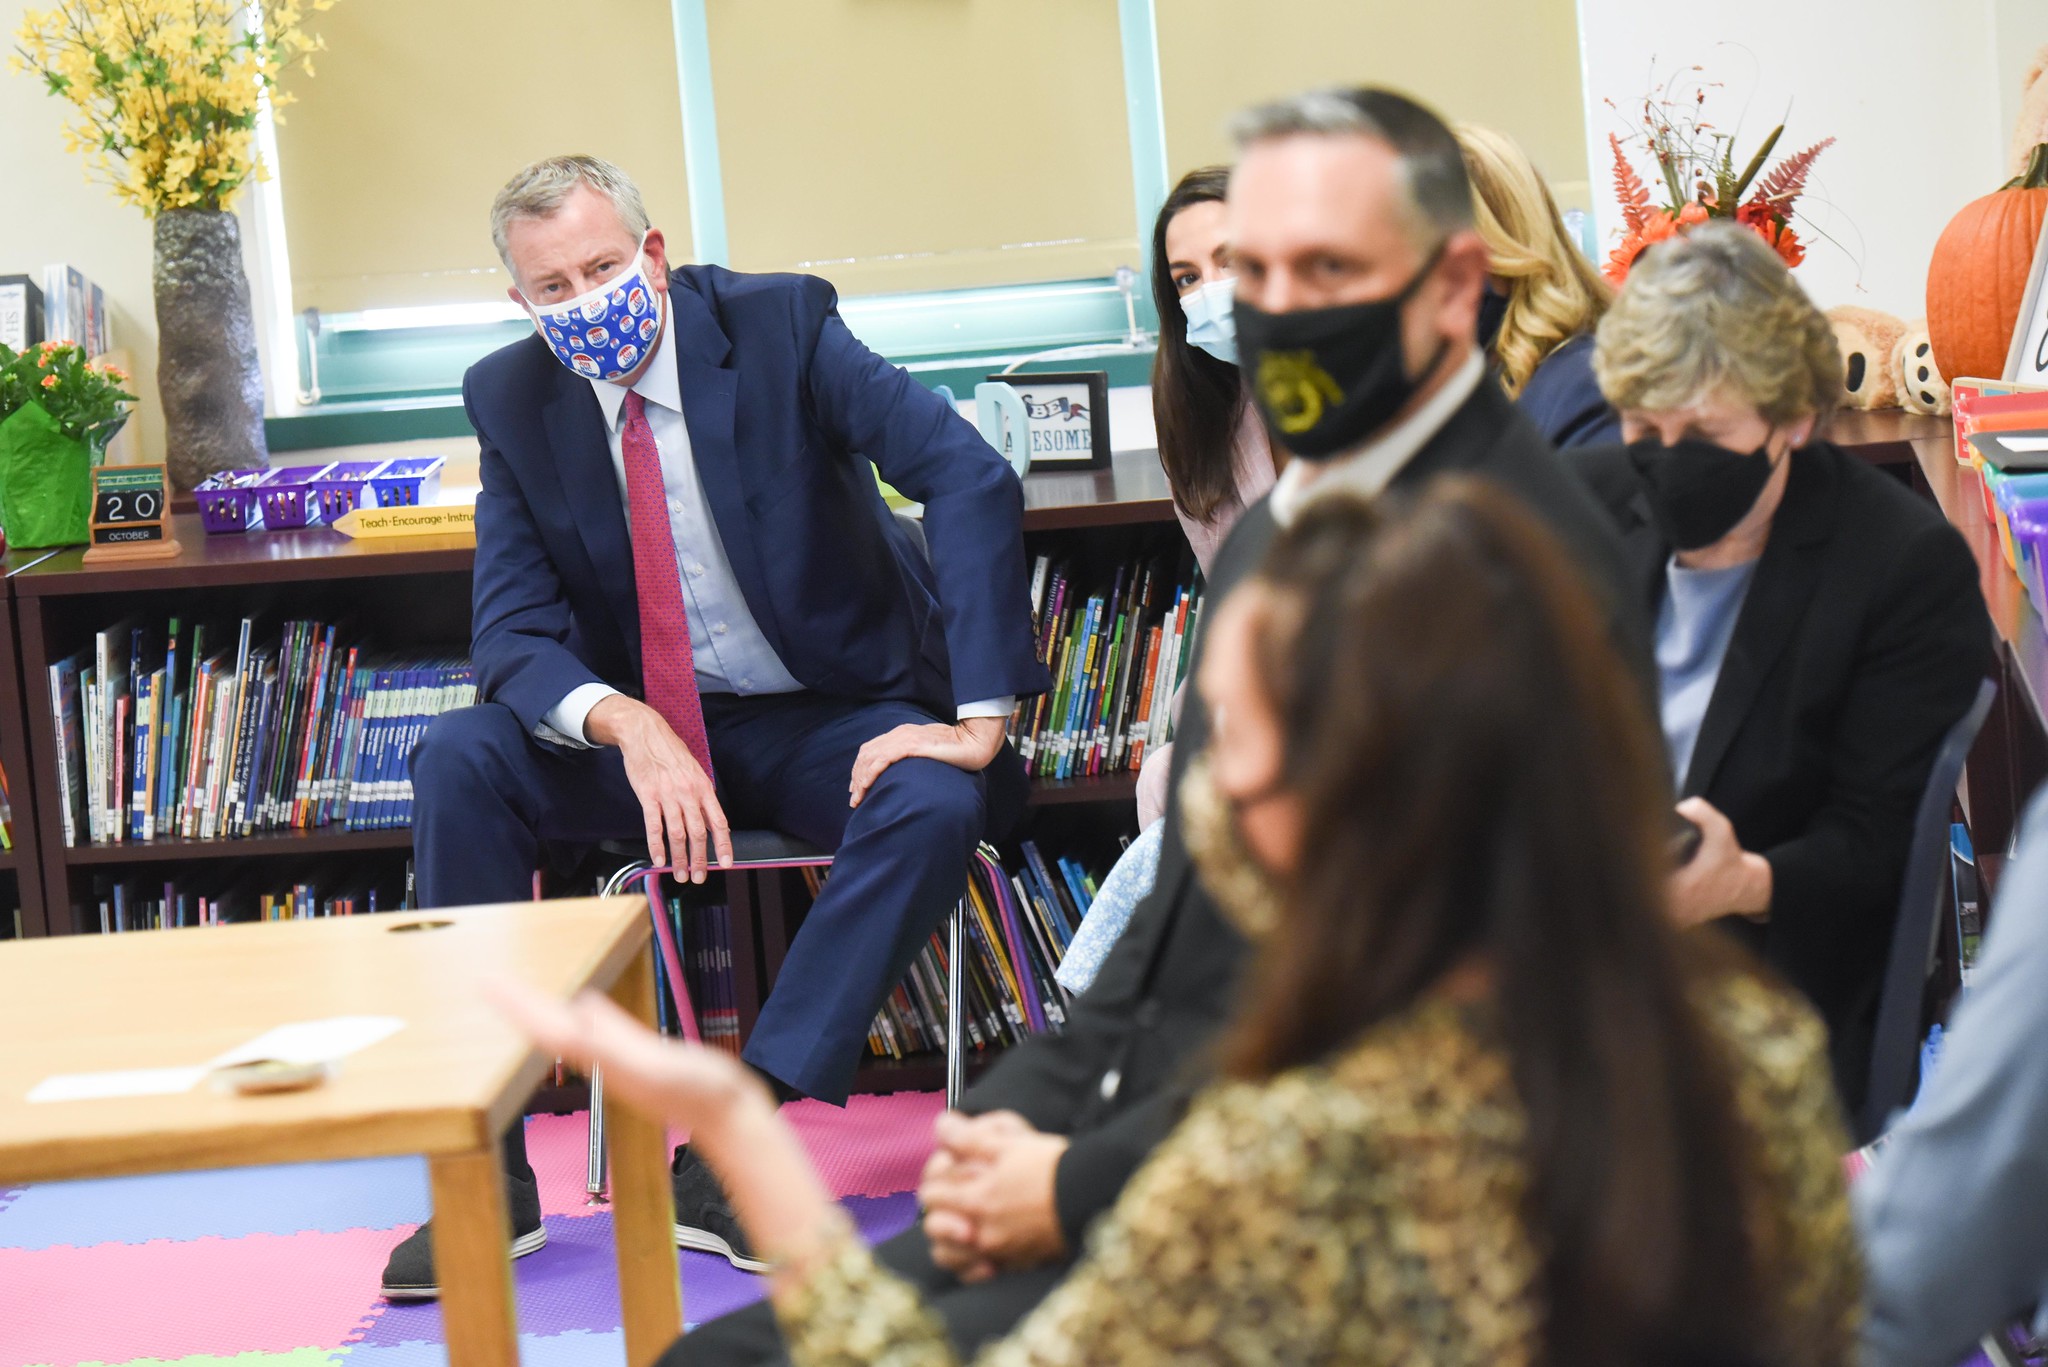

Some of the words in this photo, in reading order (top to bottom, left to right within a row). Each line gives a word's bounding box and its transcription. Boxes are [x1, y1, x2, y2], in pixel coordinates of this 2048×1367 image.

[1034, 400, 1061, 416] BE
[1005, 428, 1092, 453] AESOME
[360, 518, 388, 529] Teach
[392, 514, 442, 527] Encourage
[447, 512, 474, 523] Instru
[108, 531, 150, 541] OCTOBER
